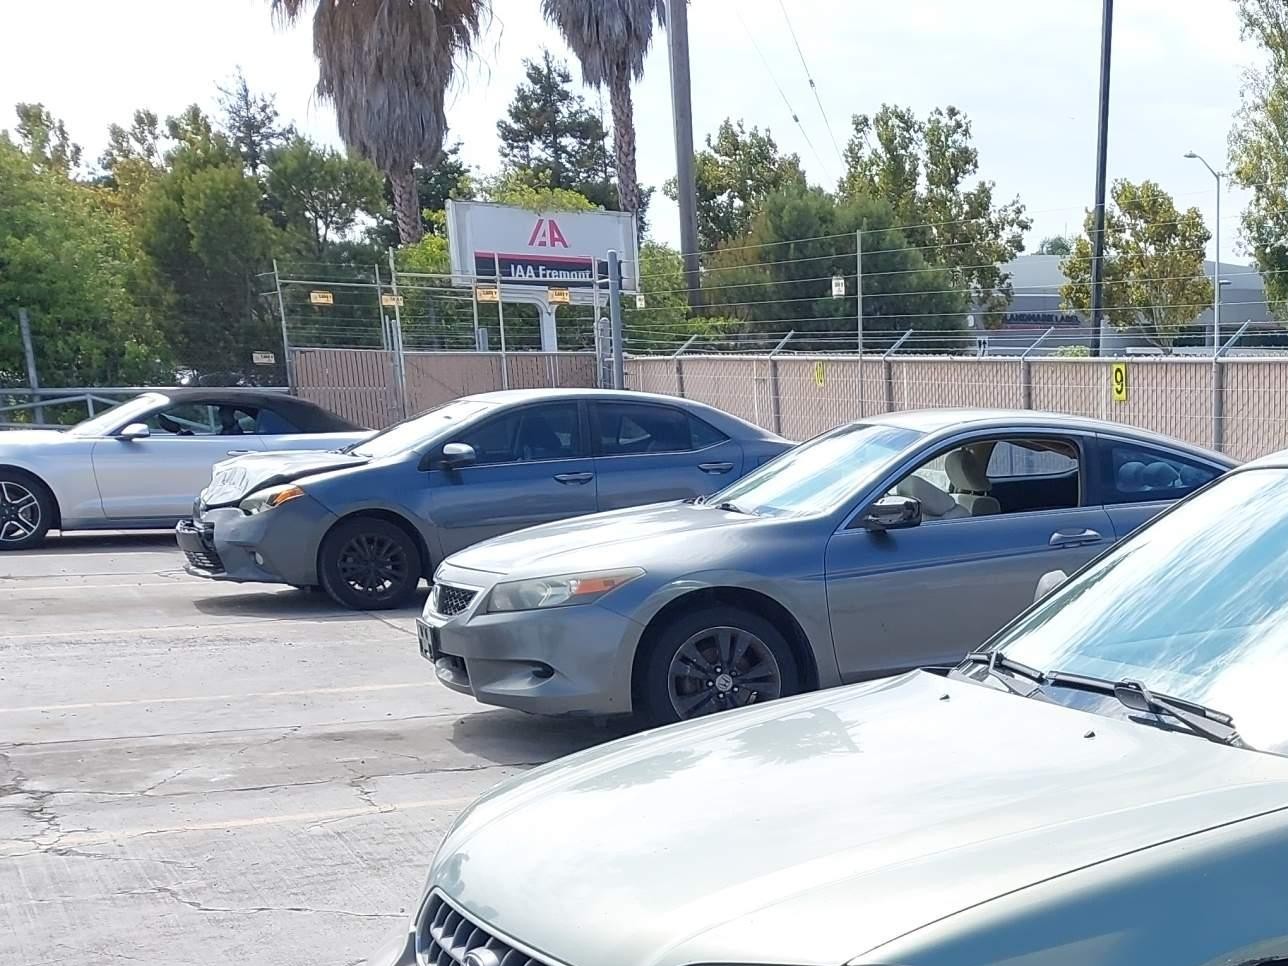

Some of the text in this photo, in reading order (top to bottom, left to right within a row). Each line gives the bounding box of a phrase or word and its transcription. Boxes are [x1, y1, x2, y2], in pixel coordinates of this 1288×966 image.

[511, 263, 592, 280] IAA Fremont
[1114, 367, 1124, 395] 9
